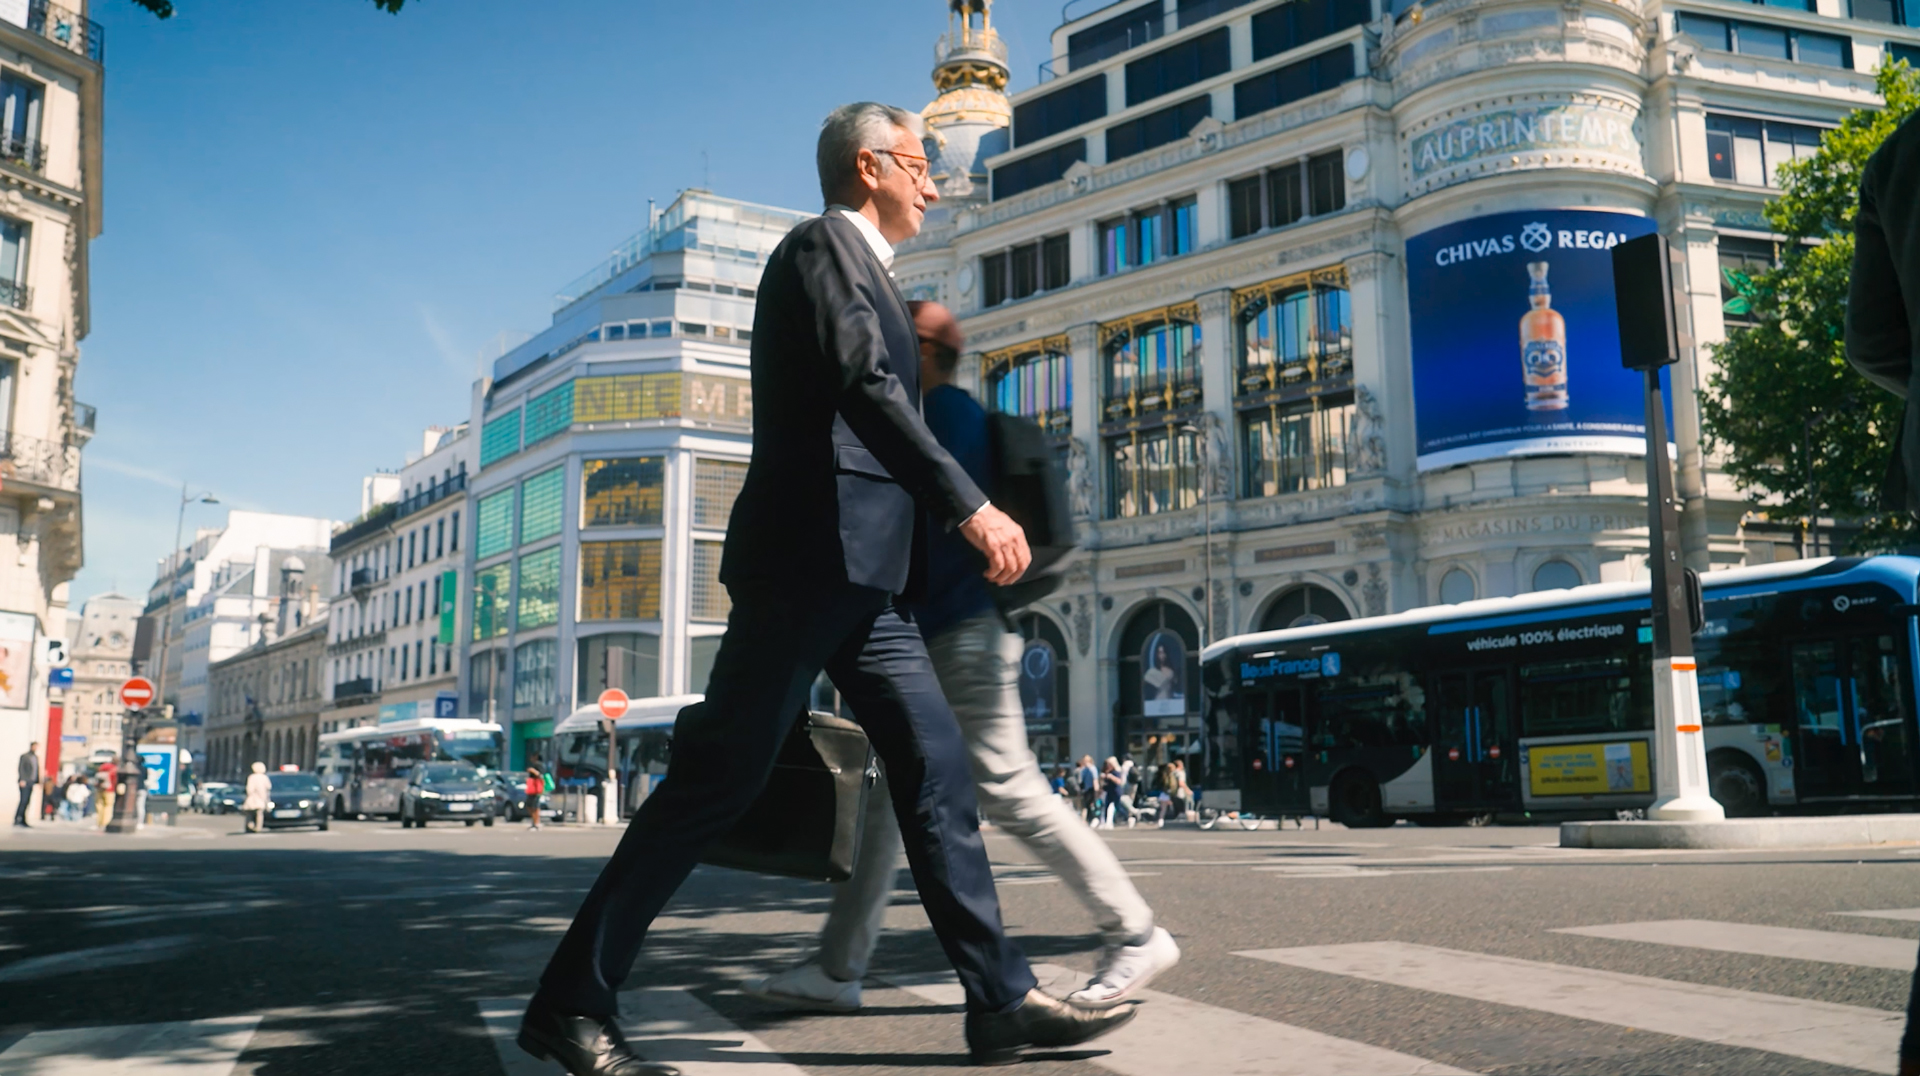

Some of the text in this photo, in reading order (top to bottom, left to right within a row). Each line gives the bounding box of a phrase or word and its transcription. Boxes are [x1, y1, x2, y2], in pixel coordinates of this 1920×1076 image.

[1435, 234, 1516, 266] CHIVAS
[1444, 517, 1542, 540] MAGASINS
[1552, 515, 1580, 530] DU
[1466, 623, 1625, 652] véhicule 100% électrique
[441, 701, 454, 717] P
